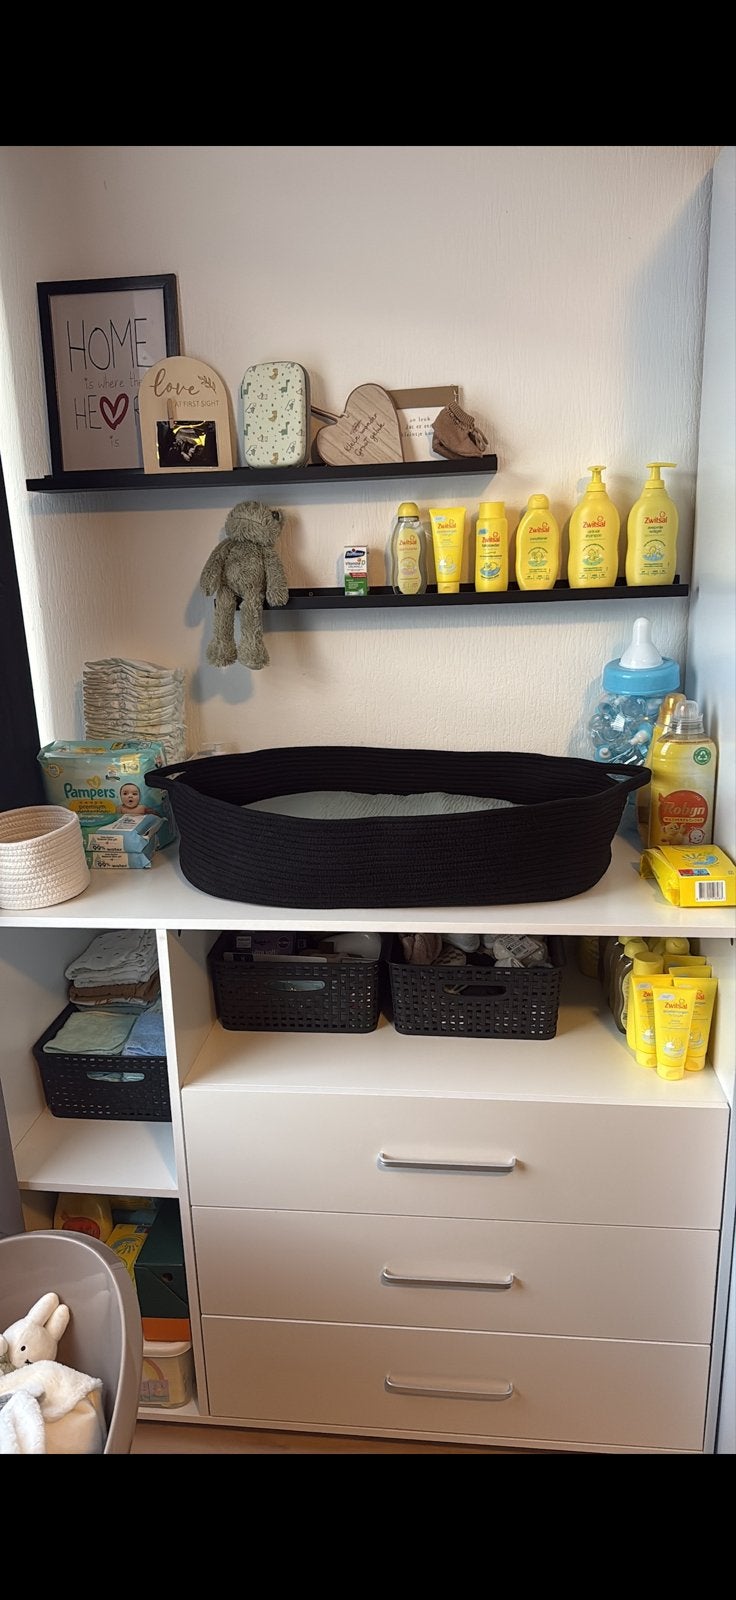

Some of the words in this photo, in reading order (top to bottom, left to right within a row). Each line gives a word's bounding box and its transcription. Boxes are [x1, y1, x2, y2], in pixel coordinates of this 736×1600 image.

[66, 317, 152, 372] HOME
[84, 377, 94, 390] is
[97, 375, 124, 389] where
[150, 367, 199, 398] love
[175, 400, 183, 408] AT
[183, 400, 200, 408] FIRST
[200, 399, 219, 407] SIGHT
[109, 435, 120, 448] is
[437, 521, 457, 529] Zwitsal
[582, 519, 606, 529] Zwitsal
[644, 515, 668, 525] Zwitsal
[528, 524, 550, 534] Zwitsal
[399, 537, 417, 546] Zwitsal
[482, 534, 500, 544] Zwitsal
[63, 782, 116, 800] Pampers
[663, 801, 706, 818] Robijn
[664, 1000, 688, 1010] Zwitsal
